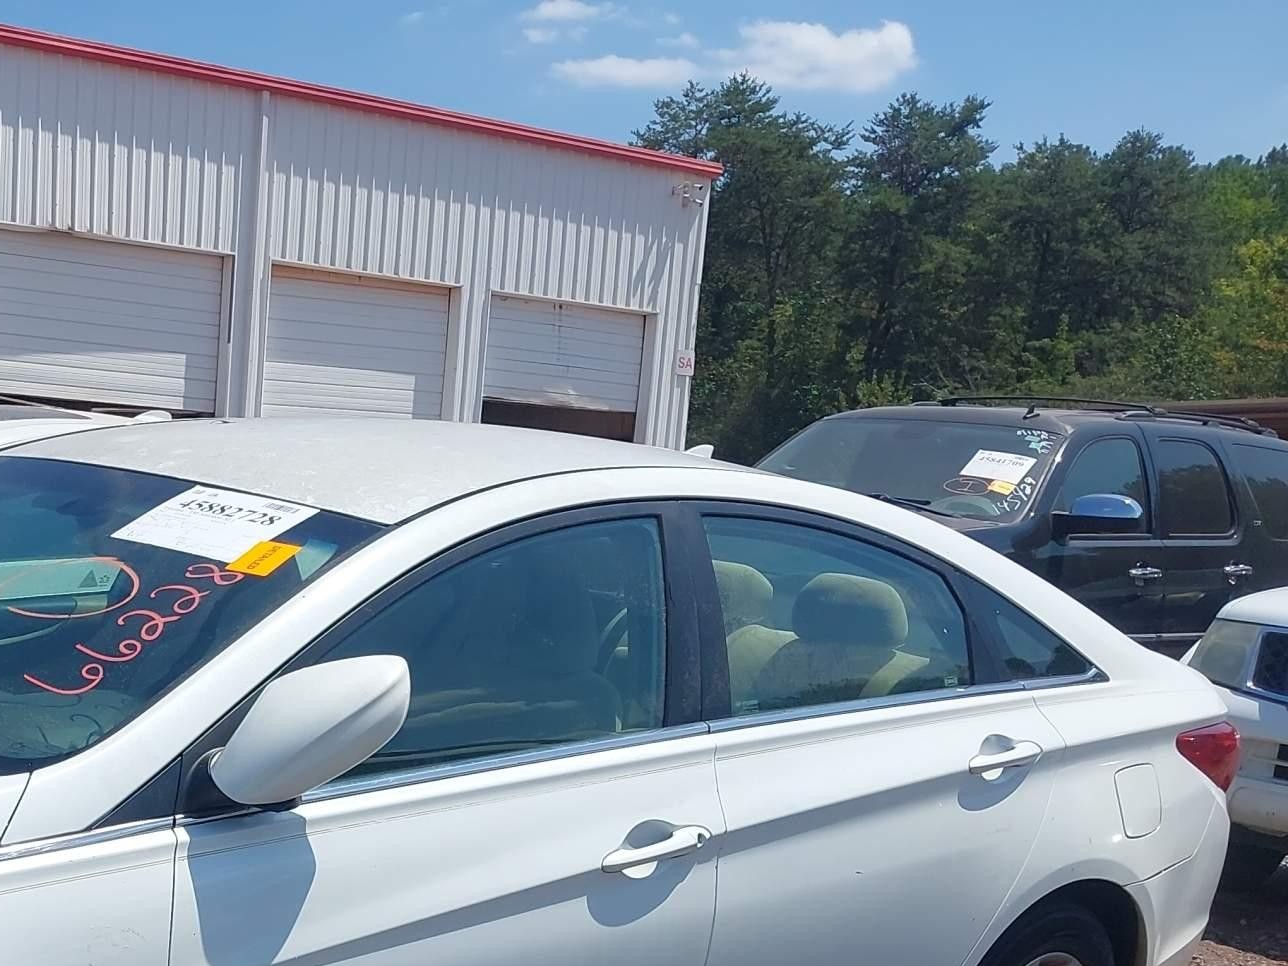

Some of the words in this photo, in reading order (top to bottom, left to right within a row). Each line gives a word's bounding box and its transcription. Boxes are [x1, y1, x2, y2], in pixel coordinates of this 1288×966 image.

[678, 356, 692, 369] SA
[179, 500, 282, 526] 45882728
[23, 563, 246, 695] 66228
